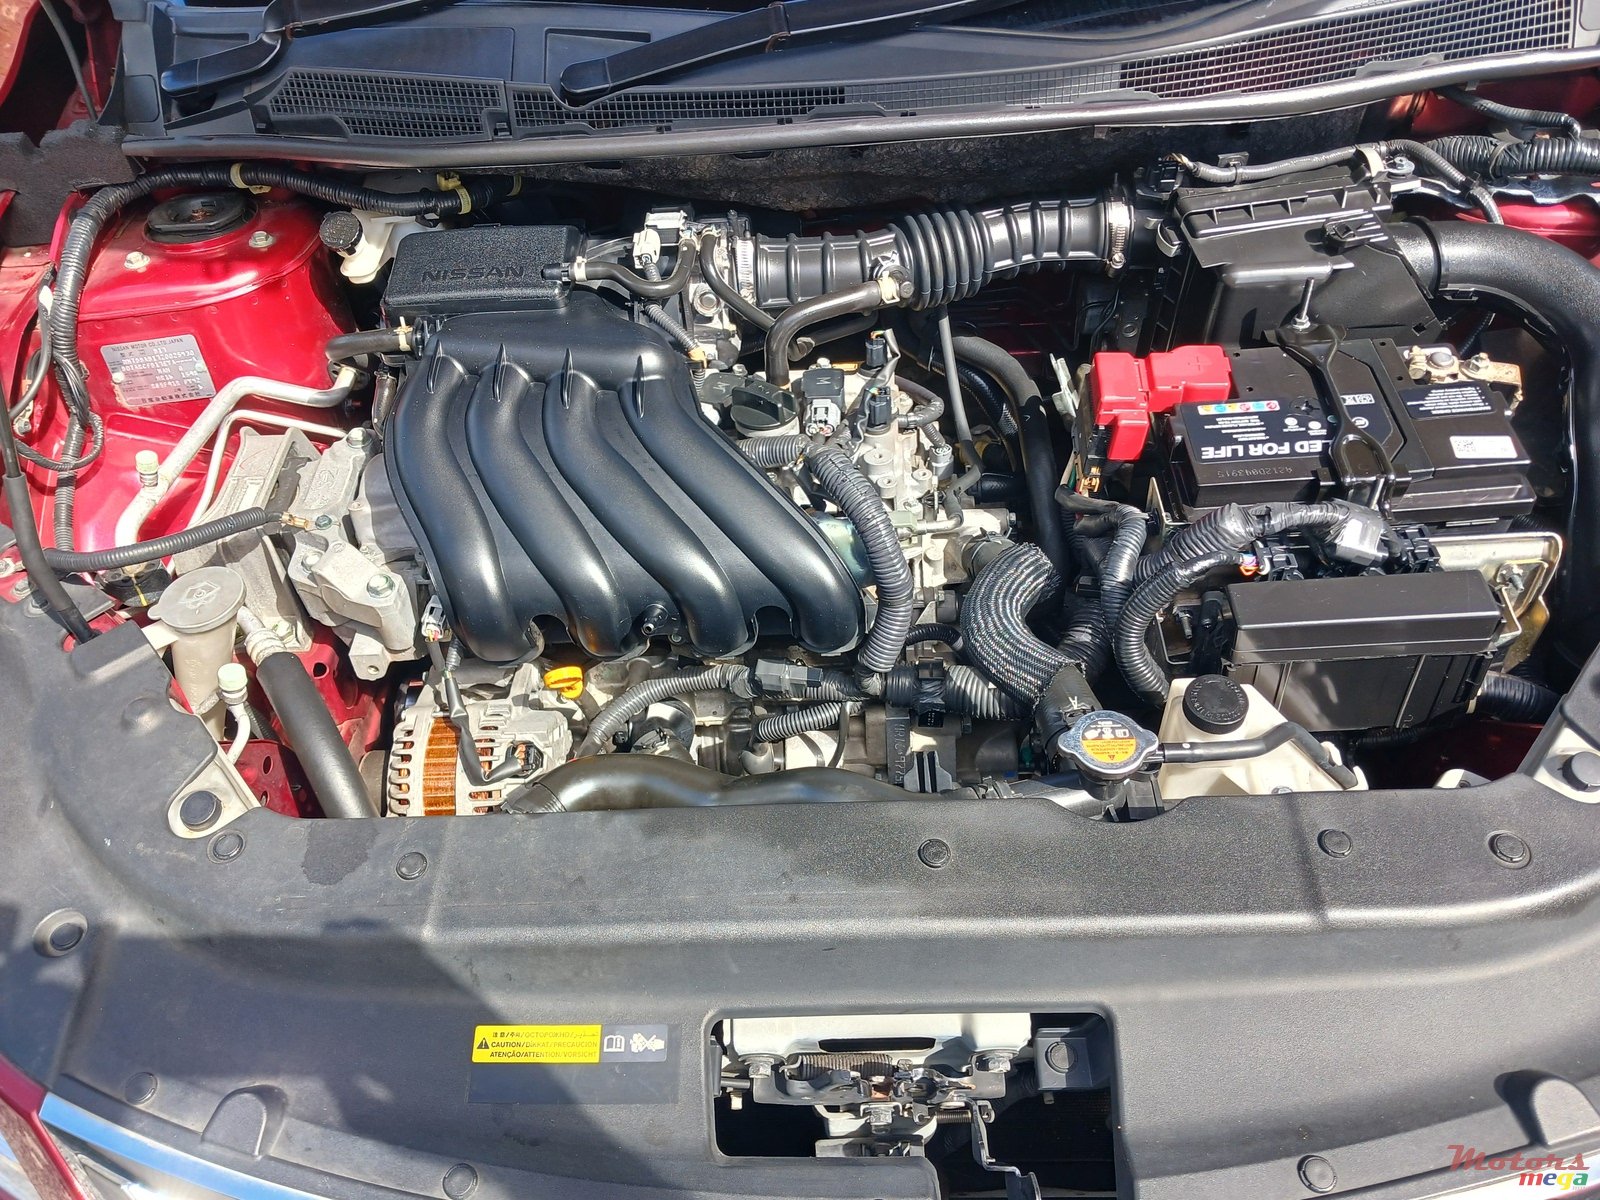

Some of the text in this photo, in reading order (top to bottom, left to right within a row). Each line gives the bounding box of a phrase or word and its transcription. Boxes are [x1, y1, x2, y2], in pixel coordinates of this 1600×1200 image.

[421, 266, 525, 281] NISSAN
[1201, 440, 1331, 459] ED FOR LIFE
